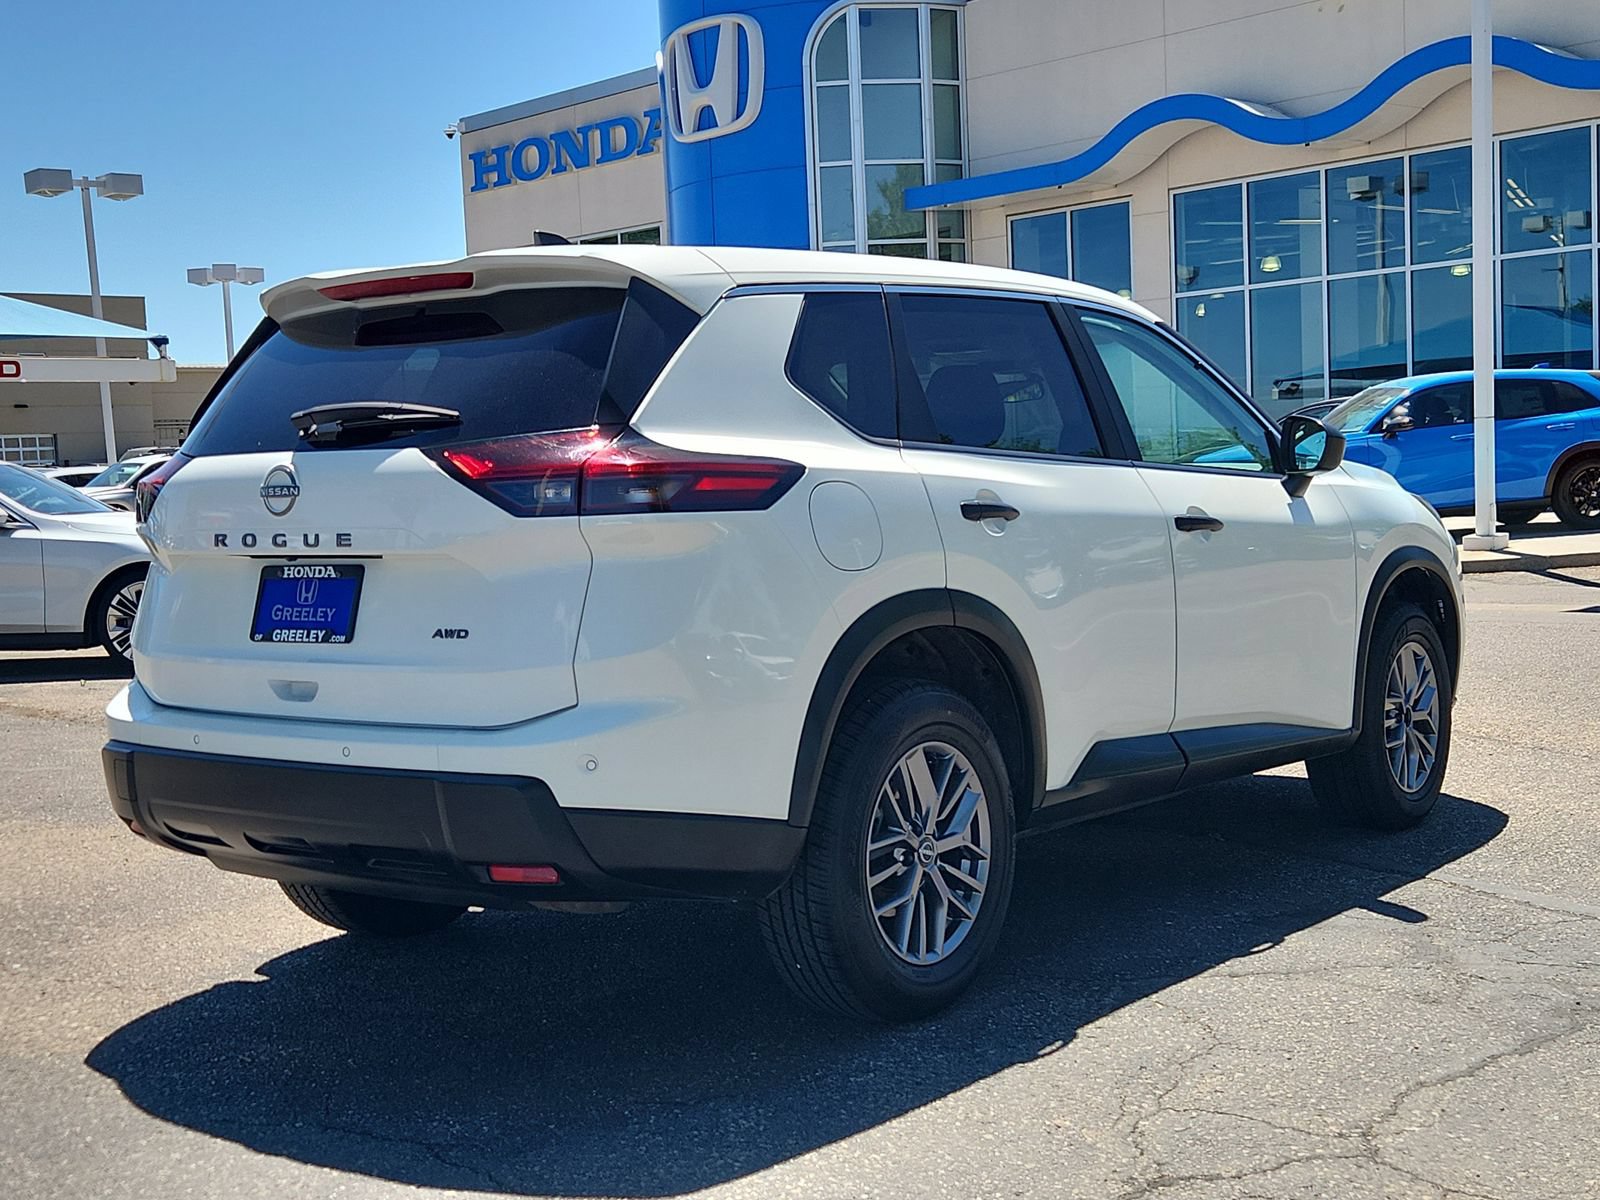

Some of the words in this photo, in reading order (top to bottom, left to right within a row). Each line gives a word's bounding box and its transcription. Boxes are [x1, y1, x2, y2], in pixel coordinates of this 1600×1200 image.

[260, 487, 298, 496] NISSAN
[214, 533, 352, 547] ROGUE
[283, 566, 336, 578] HONDA
[271, 604, 336, 622] GREELEY
[272, 629, 326, 642] GREELEY
[431, 628, 469, 639] AWD
